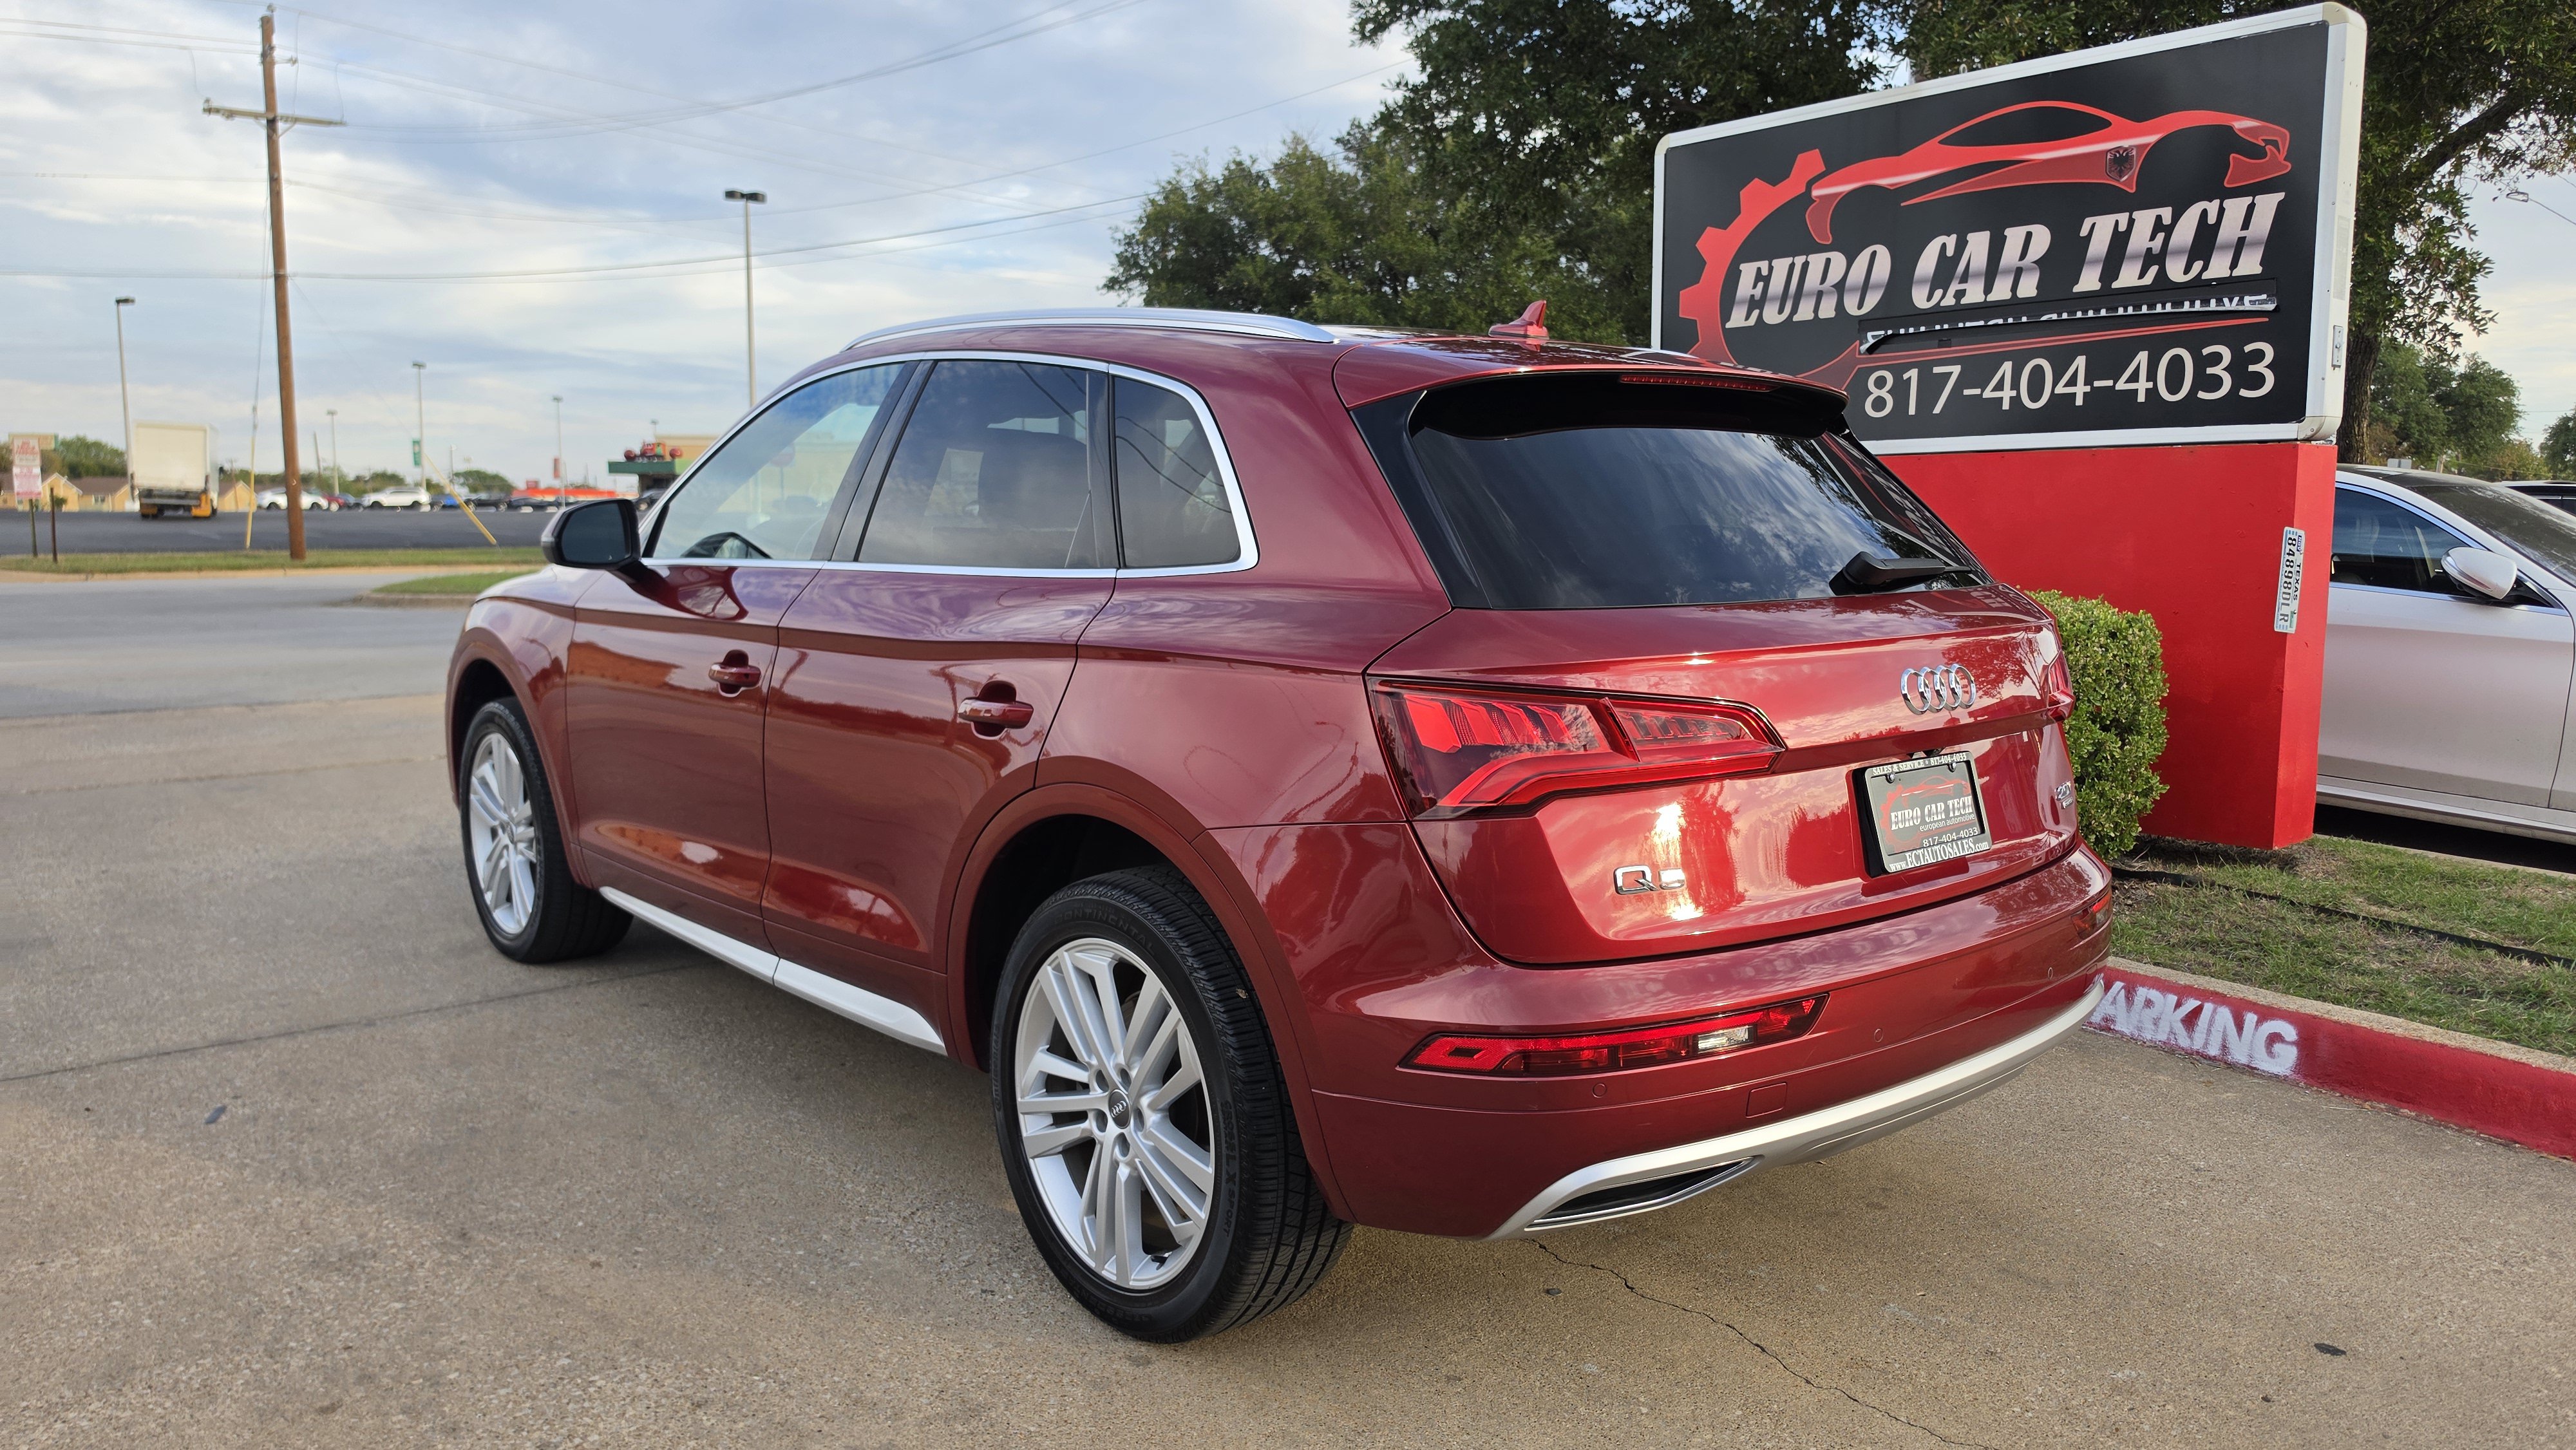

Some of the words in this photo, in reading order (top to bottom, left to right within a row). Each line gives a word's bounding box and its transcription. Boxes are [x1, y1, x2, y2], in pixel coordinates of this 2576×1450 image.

[1725, 244, 1891, 328] EURO
[1911, 223, 2051, 309] CAR
[2072, 193, 2286, 292] TECH
[1864, 341, 2275, 418] 817-404-4033
[2279, 536, 2297, 623] 84898DLR
[2293, 563, 2301, 601] TEXAS
[1873, 765, 1891, 776] SALES
[1899, 759, 1924, 771] SERVICE
[1930, 753, 1967, 766] 817-404-4033
[1891, 807, 1921, 831] EURO
[1925, 802, 1945, 822] CAR
[1947, 796, 1973, 817] TECH
[1920, 820, 1946, 831] european
[1947, 814, 1975, 825] automotive
[1889, 838, 1989, 872] www.ECTAUTOSALES.com
[1923, 827, 1978, 847] 817-404-4033
[1613, 864, 1685, 895] Q5
[2088, 980, 2298, 1077] ARKING
[1223, 1187, 1236, 1238] SPORT
